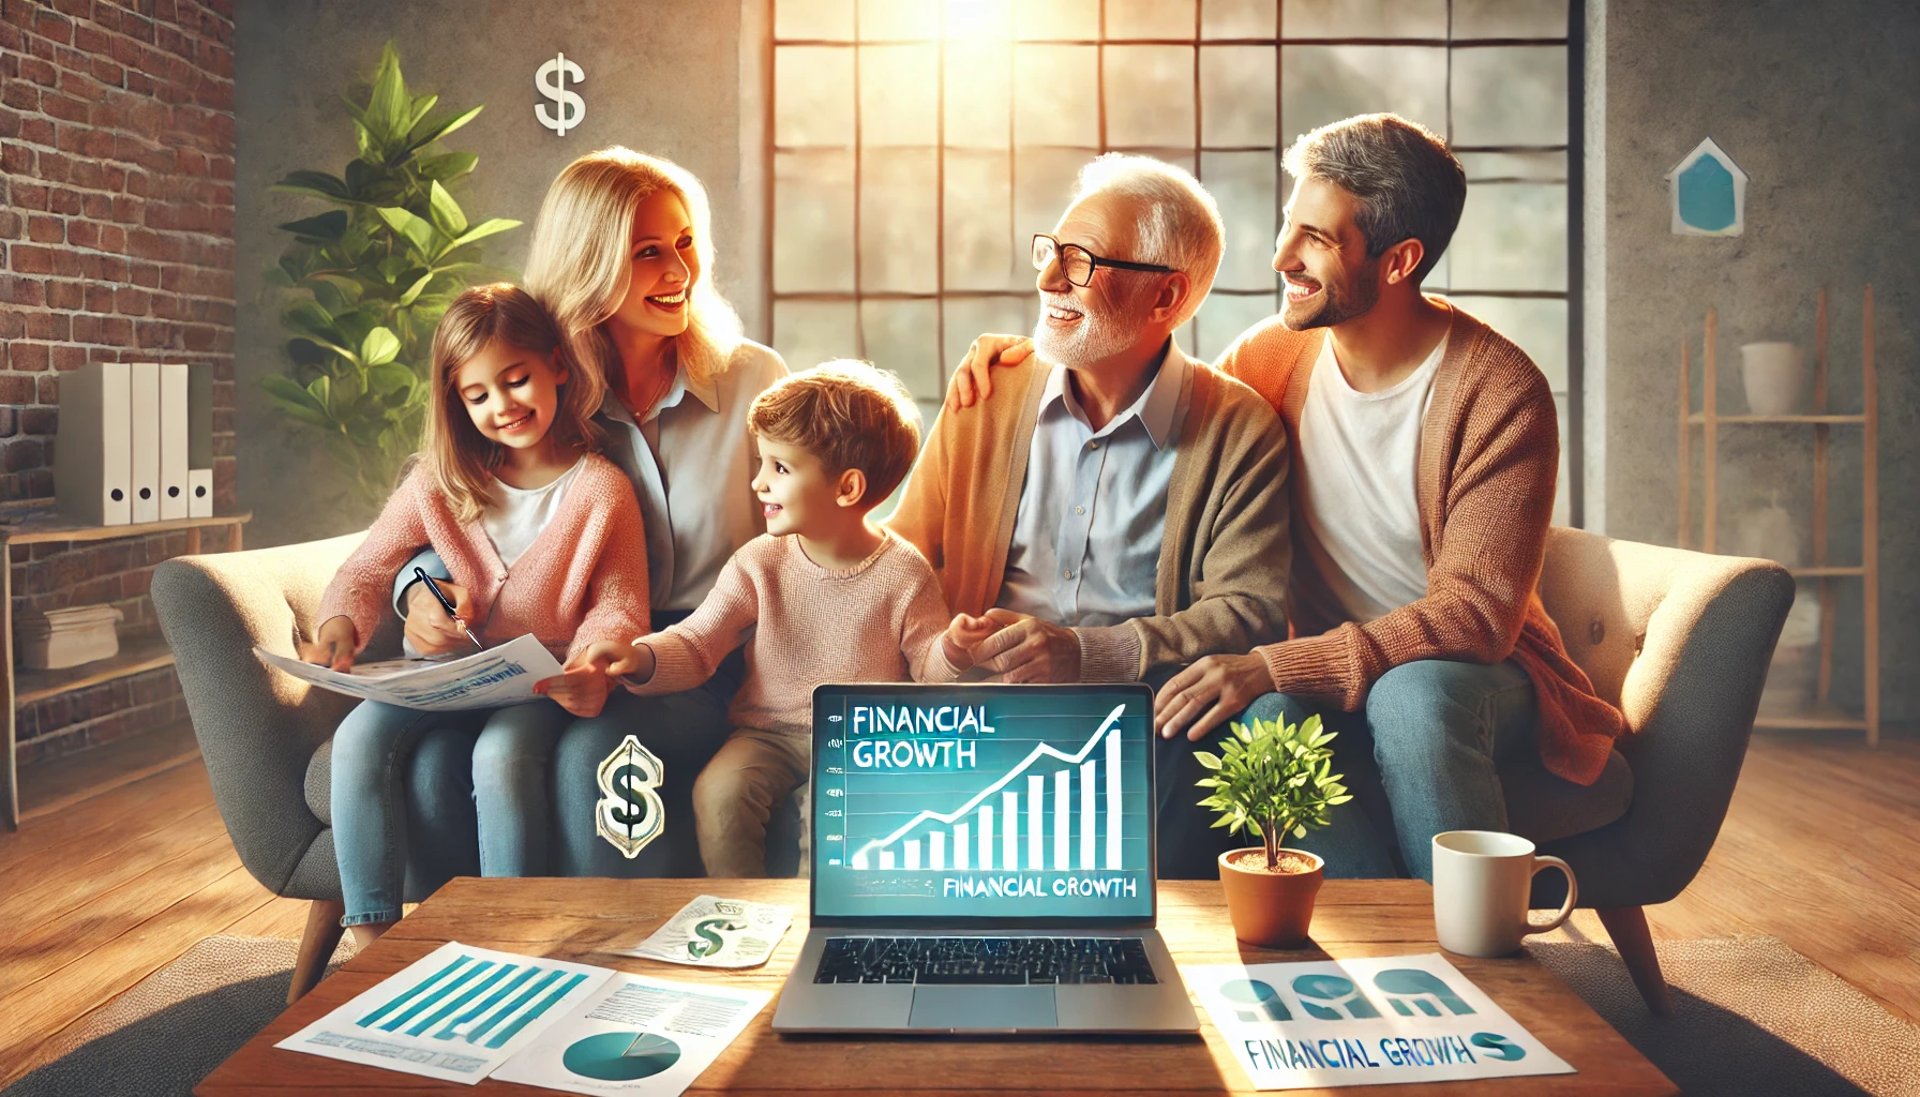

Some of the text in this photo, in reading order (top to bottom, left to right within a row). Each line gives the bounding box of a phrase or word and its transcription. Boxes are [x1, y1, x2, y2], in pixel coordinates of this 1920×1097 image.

[853, 705, 996, 734] FINANCIAL
[853, 739, 976, 768] GROWTH
[943, 874, 1048, 898] FINANCIAL
[1245, 1038, 1380, 1070] FINANCIAL
